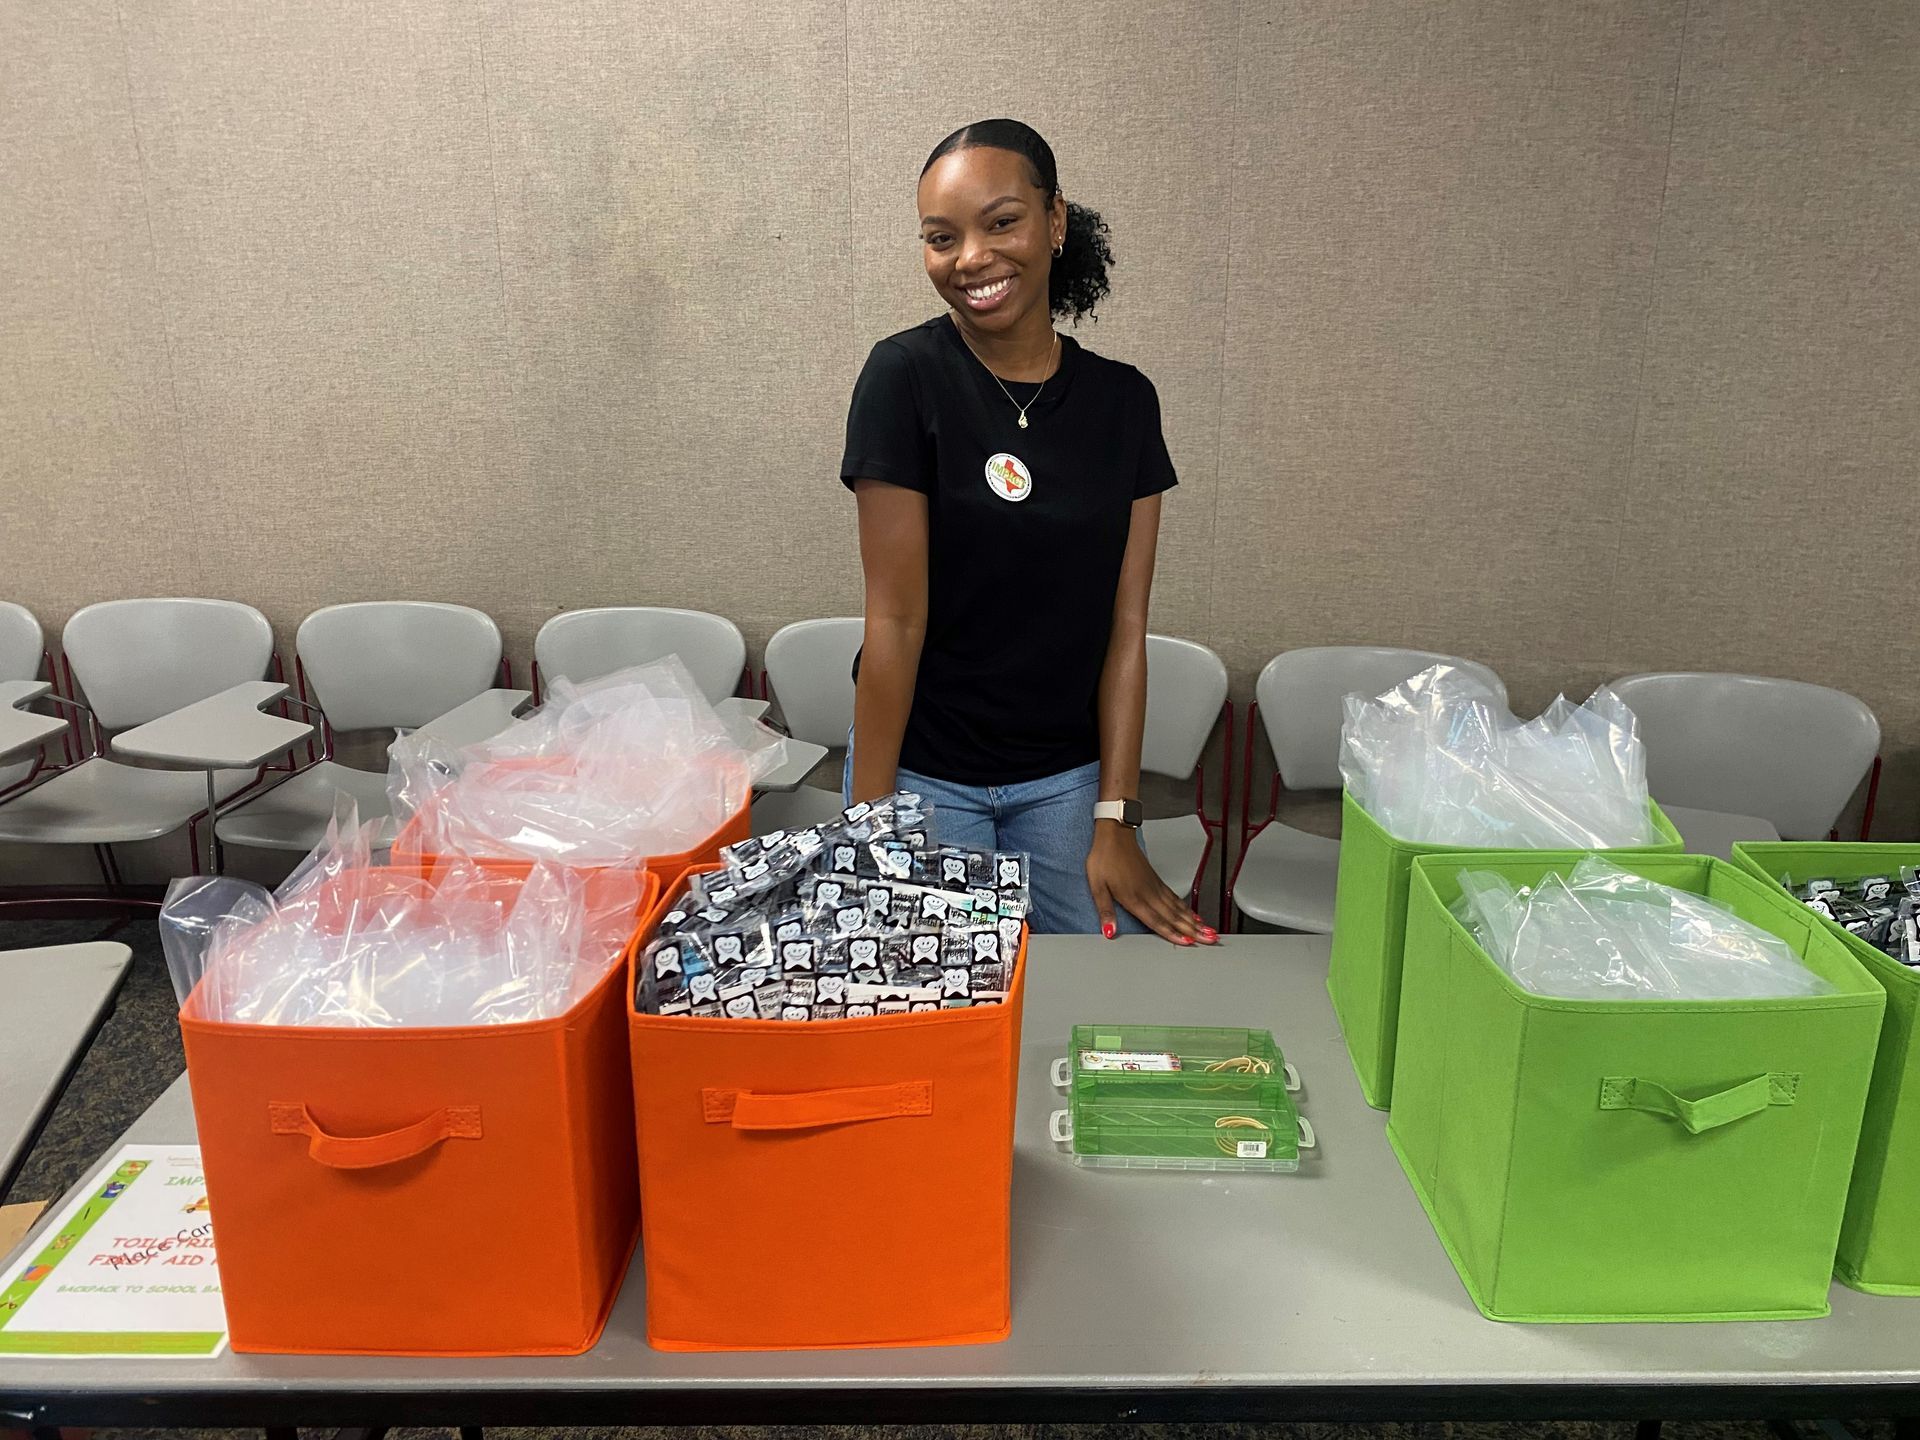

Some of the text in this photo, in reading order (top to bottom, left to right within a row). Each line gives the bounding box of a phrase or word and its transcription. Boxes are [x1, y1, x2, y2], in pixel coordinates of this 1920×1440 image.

[1001, 902, 1026, 913] Teeth!
[163, 1176, 204, 1186] IMP
[161, 1255, 204, 1265] AID
[125, 1285, 144, 1293] TO
[146, 1285, 197, 1293] SCHOOL
